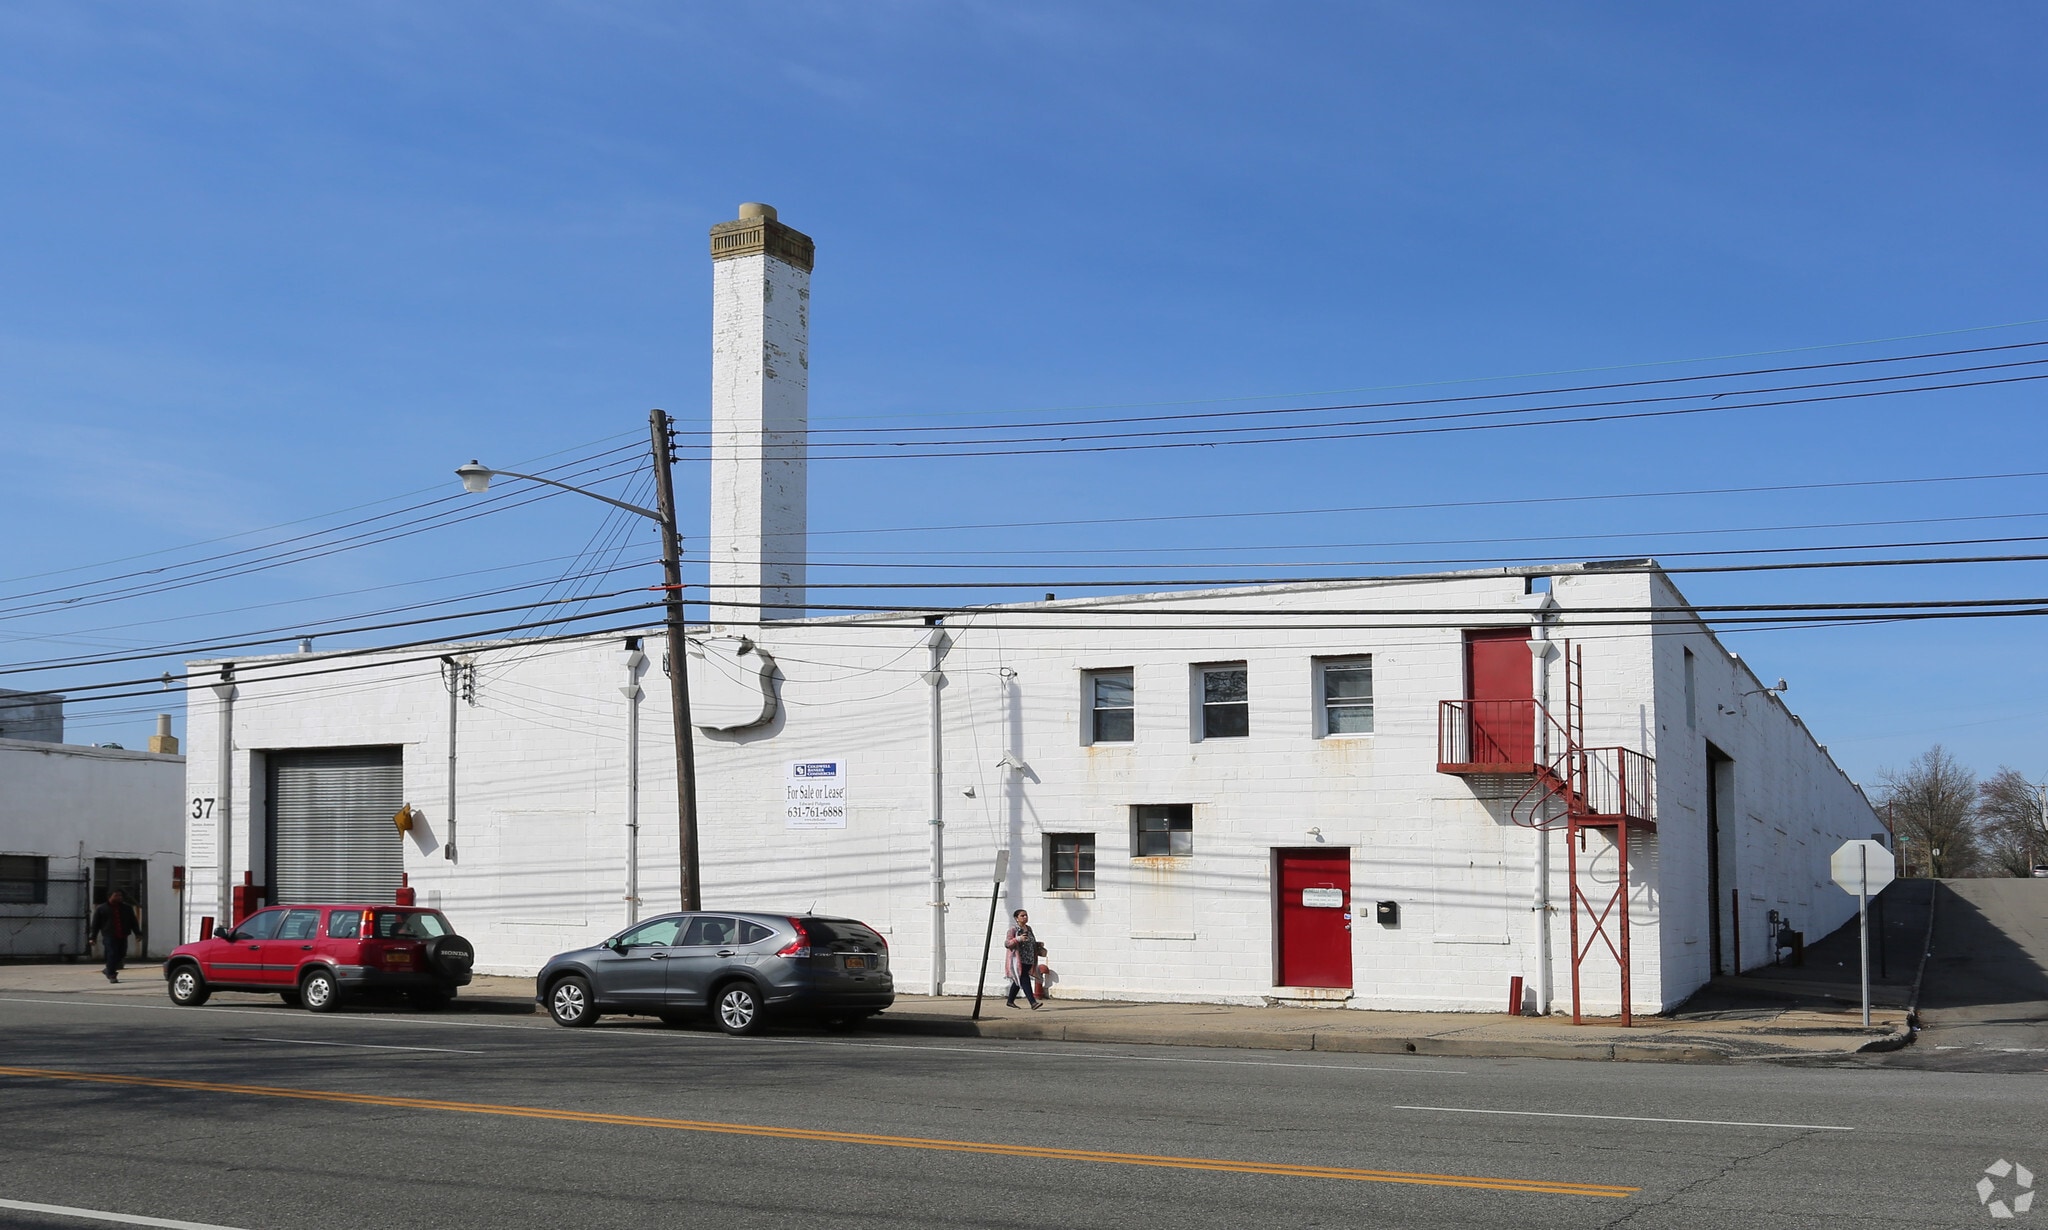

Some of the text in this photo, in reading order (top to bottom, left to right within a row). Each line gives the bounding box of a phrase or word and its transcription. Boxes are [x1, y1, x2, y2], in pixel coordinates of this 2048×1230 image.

[787, 784, 843, 800] For Sale or Lease
[192, 797, 215, 819] 37
[787, 806, 843, 818] 631-761-6888
